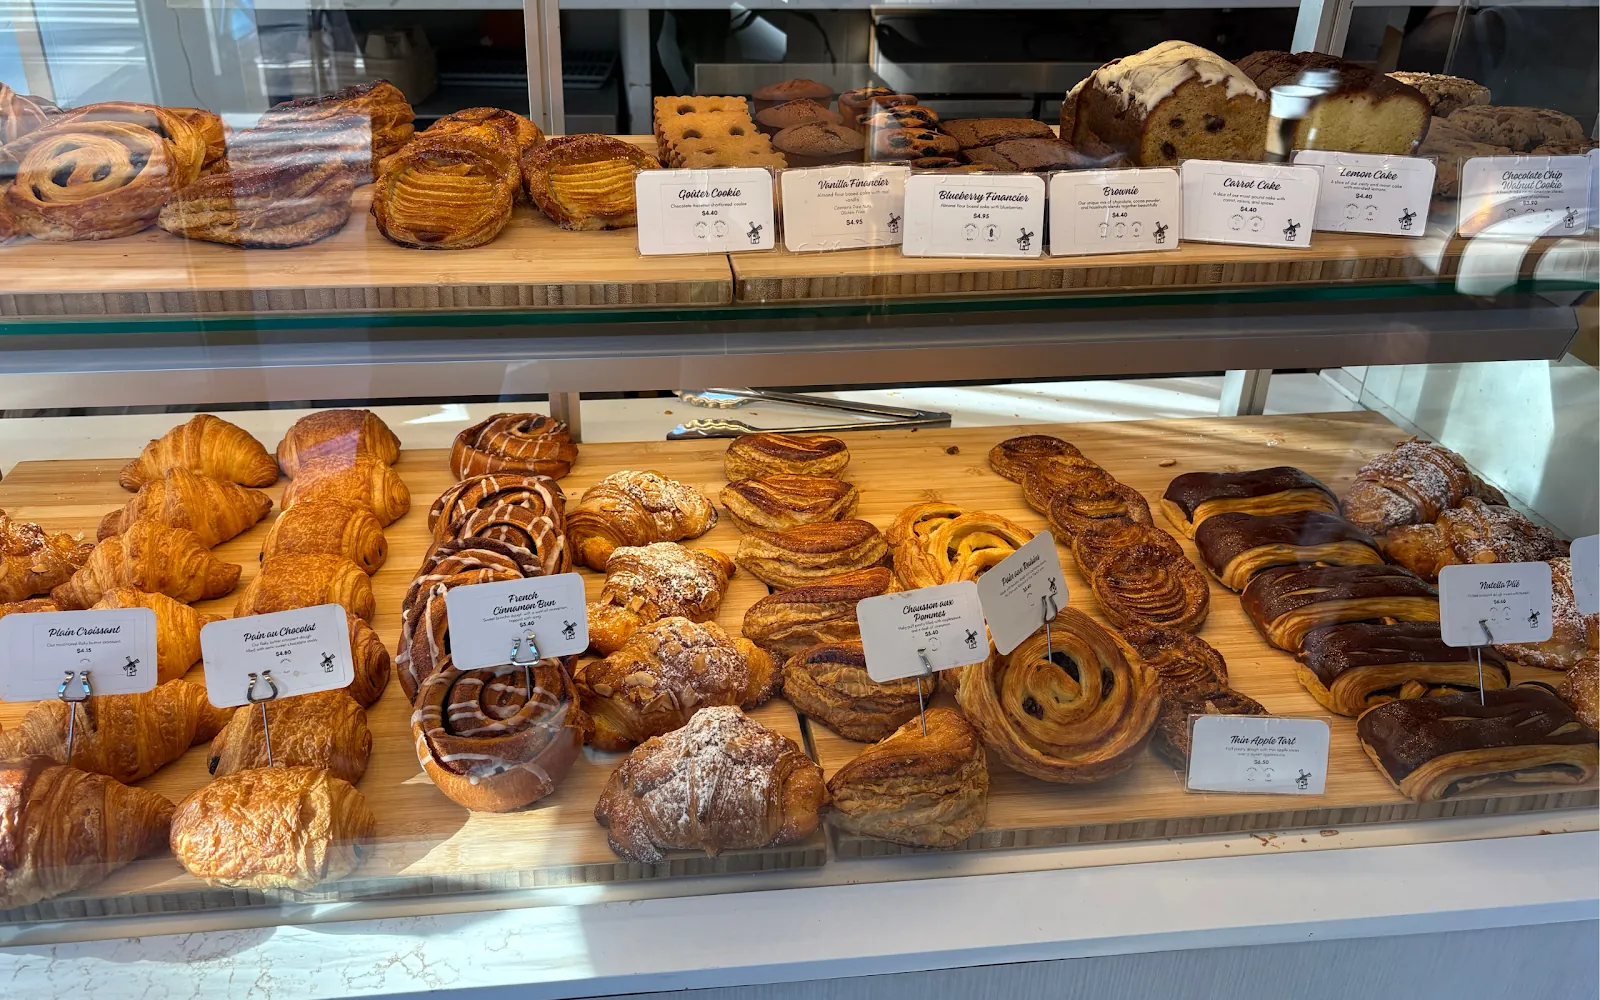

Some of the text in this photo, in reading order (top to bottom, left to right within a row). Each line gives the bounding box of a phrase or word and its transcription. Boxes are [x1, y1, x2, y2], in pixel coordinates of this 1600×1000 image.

[1340, 168, 1398, 180] Lemon Cake
[1502, 170, 1563, 181] Chocolate Chip
[817, 178, 890, 190] Vanilla Financier
[1223, 178, 1282, 190] Carrot Cake
[1502, 180, 1562, 190] Walnut Cookie
[678, 188, 742, 200] Goûter Cookie
[938, 190, 1030, 203] Blueberry Financier
[1103, 185, 1140, 197] Brownie
[1479, 581, 1506, 590] Nutella
[507, 591, 540, 603] French
[493, 600, 556, 615] Cinnamon Bun
[902, 599, 955, 615] Chausson aux
[913, 610, 946, 622] Pommes
[48, 625, 121, 638] Plain Croissant
[244, 622, 317, 642] Pain au Chocolat
[1230, 735, 1297, 747] Thin Apple Tart
